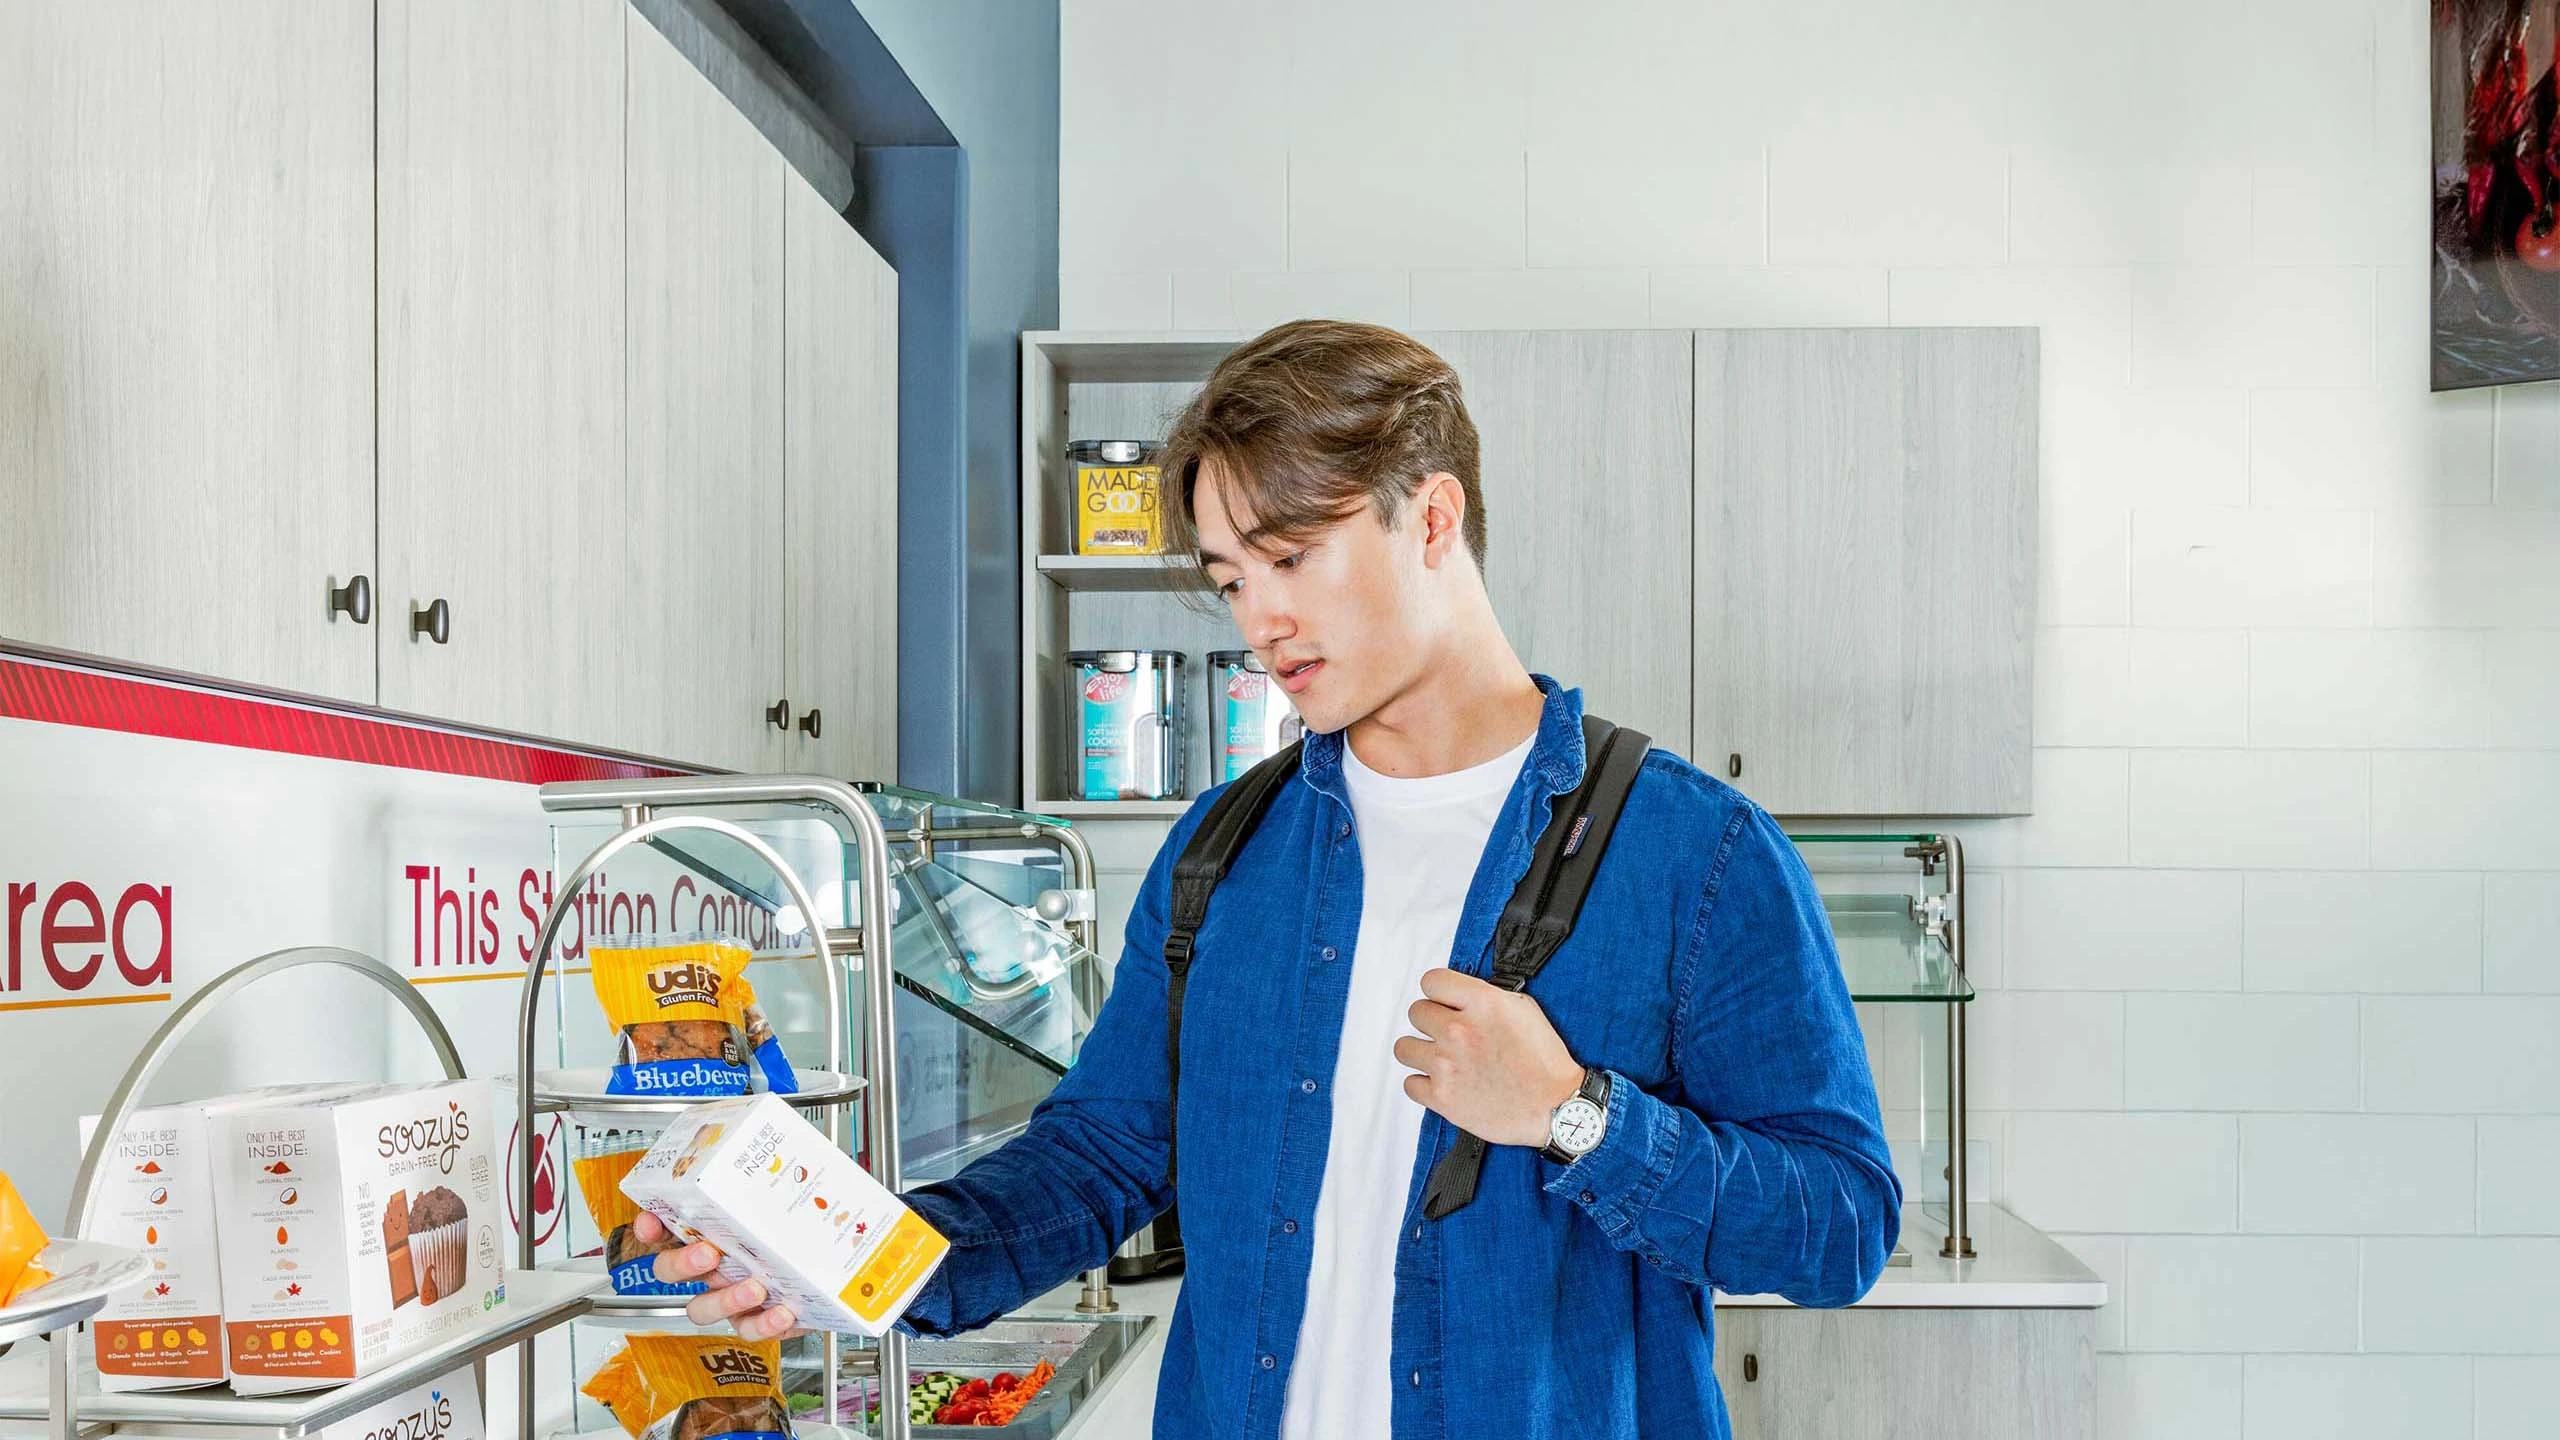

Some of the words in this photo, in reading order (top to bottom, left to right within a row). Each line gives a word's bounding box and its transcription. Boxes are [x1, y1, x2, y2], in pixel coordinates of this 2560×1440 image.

[1087, 471, 1155, 490] MADE
[1087, 492, 1154, 513] GOOD
[406, 865, 499, 967] This
[0, 881, 172, 991] rea
[661, 993, 695, 1006] Gluten
[697, 992, 717, 1006] Free
[141, 1131, 156, 1141] THE
[160, 1130, 177, 1141] BEST
[246, 1132, 265, 1144] ONLY
[270, 1131, 285, 1142] THE
[288, 1130, 305, 1142] BEST
[120, 1143, 180, 1158] INSIDE:
[248, 1143, 308, 1159] INSIDE:
[388, 1153, 437, 1176] GRAIN-FREE
[717, 1374, 745, 1385] Gluten
[745, 1375, 767, 1385] Free
